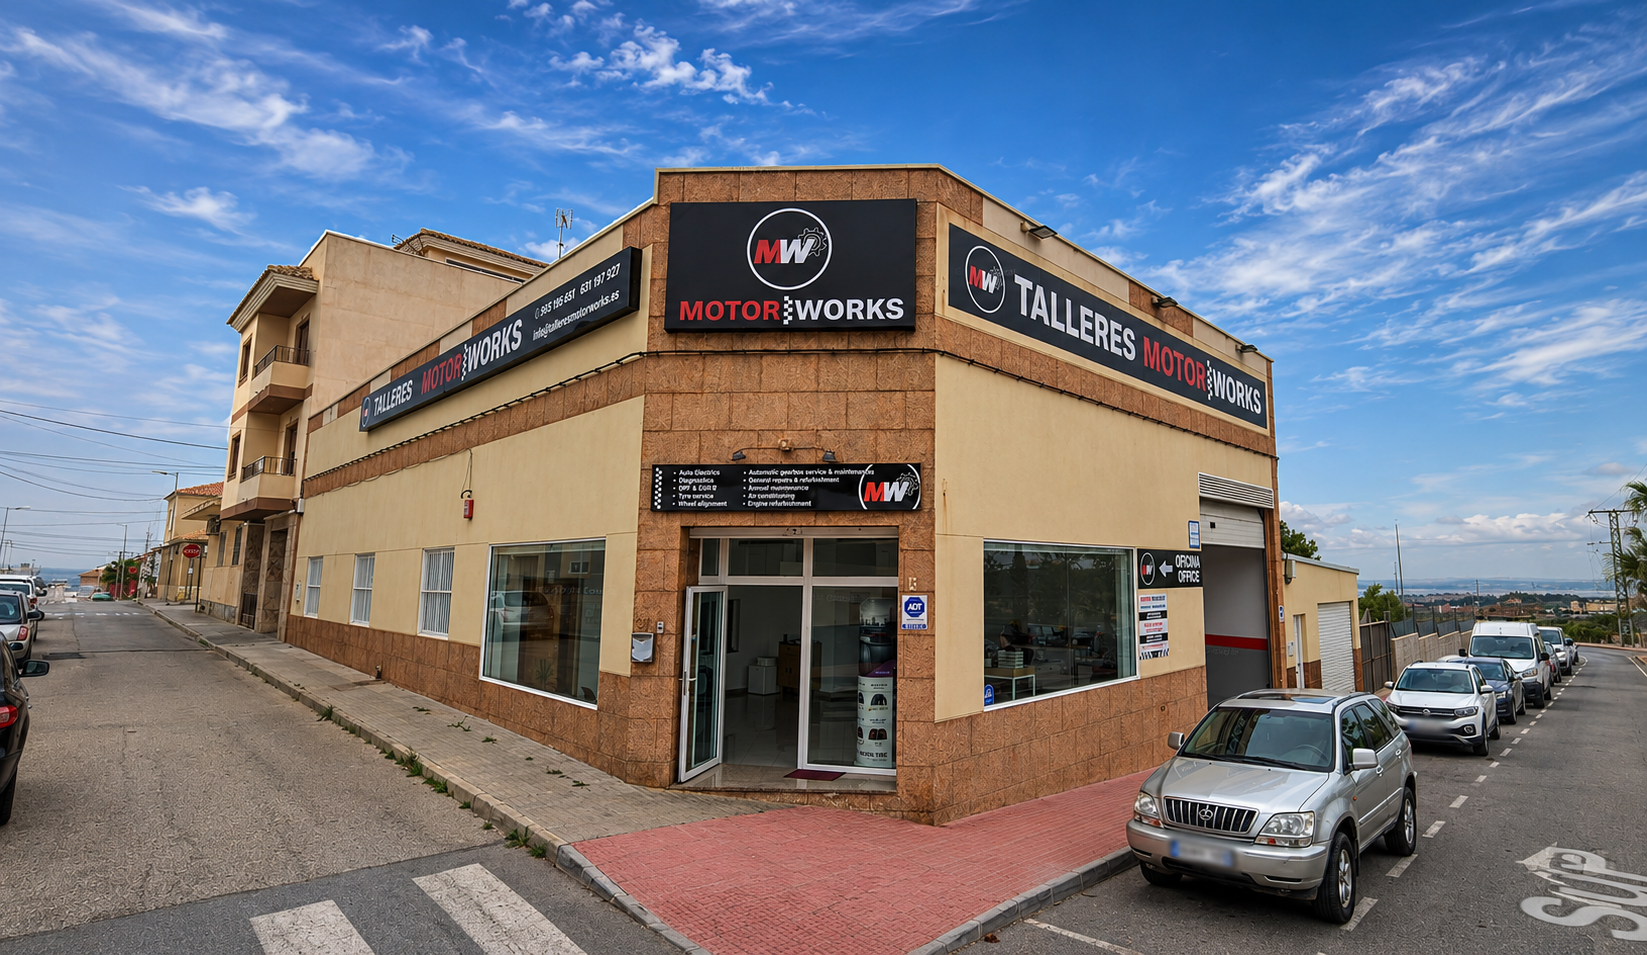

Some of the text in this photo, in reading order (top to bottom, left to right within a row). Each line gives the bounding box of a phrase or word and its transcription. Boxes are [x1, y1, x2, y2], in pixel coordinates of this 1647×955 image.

[754, 239, 815, 264] MW
[606, 263, 620, 280] 927
[968, 265, 999, 294] MW
[679, 298, 904, 321] MOTOR WORKS
[1013, 273, 1262, 415] TALLERES MOTOR WORKS
[373, 319, 522, 417] TALLERES MOTOR WORKS
[864, 481, 909, 502] MW
[1178, 570, 1200, 583] OFFICE
[907, 603, 922, 611] ADT
